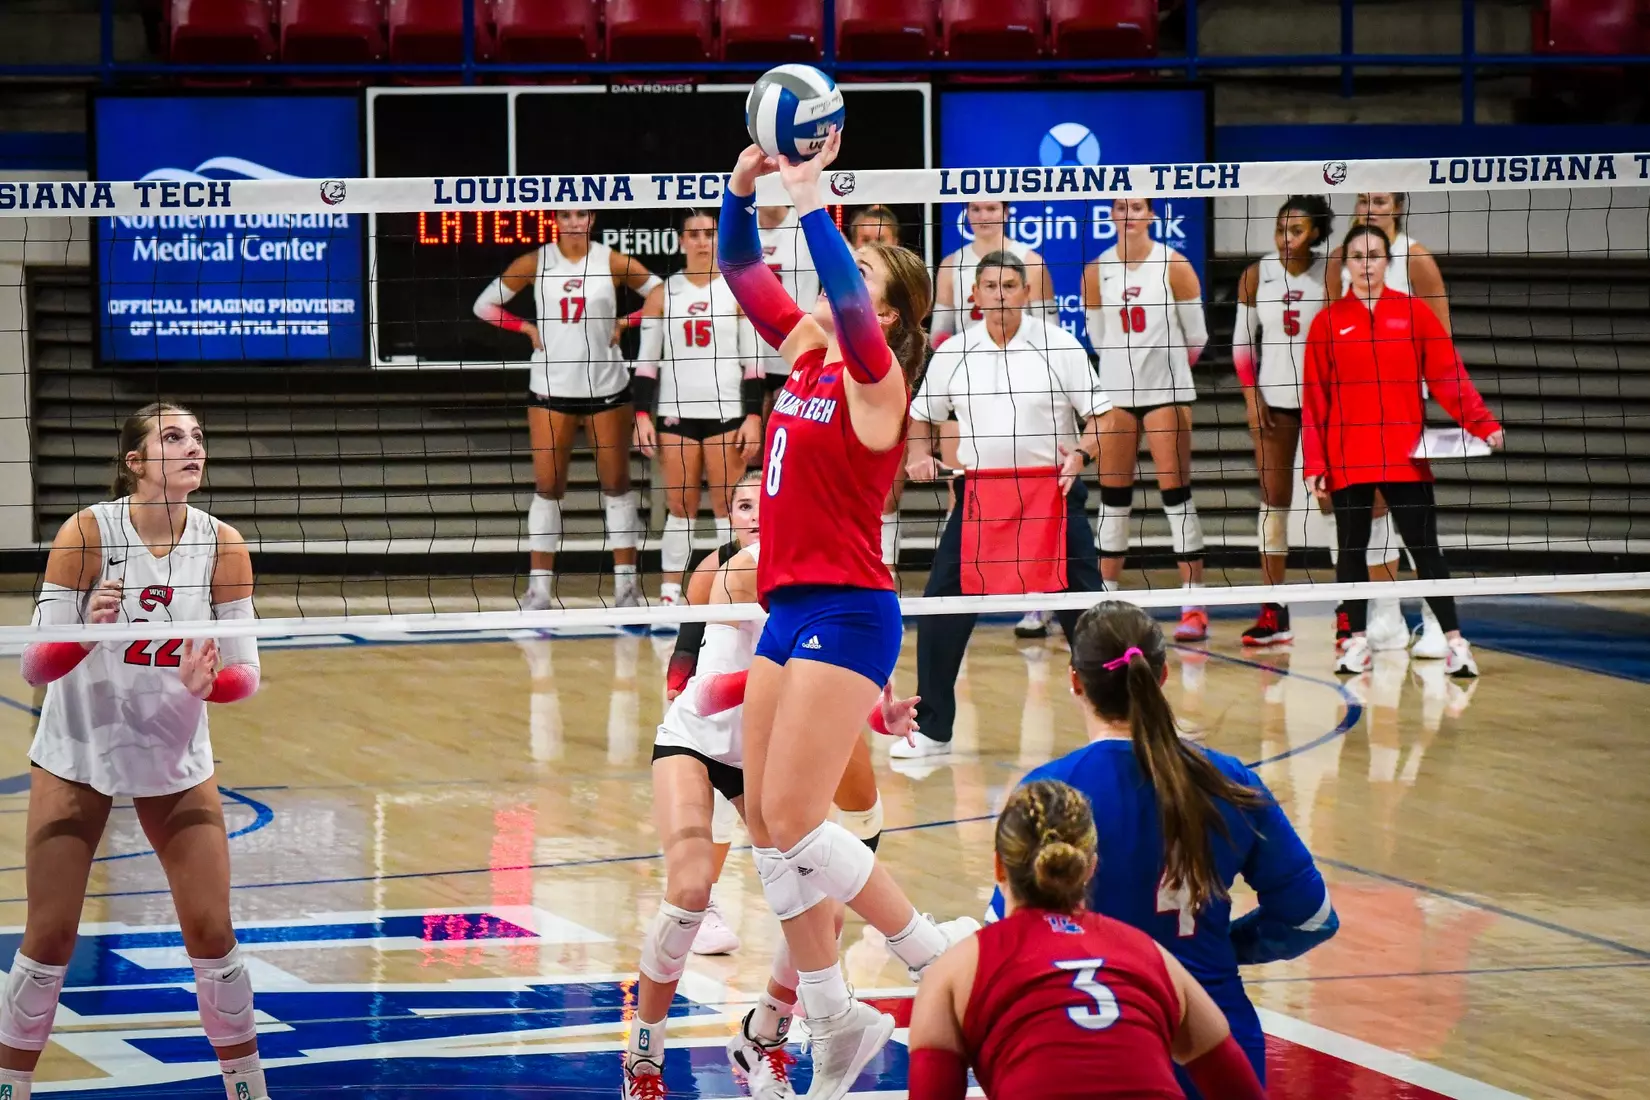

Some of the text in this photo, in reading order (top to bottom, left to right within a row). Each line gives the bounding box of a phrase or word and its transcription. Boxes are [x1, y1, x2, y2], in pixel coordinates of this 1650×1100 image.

[611, 84, 692, 93] DAKTRONICS
[939, 164, 1240, 195] LOUISIANA TECH
[1429, 155, 1616, 184] LOUISIANA
[134, 181, 231, 207] TECH
[434, 176, 633, 204] LOUISIANA
[957, 203, 1186, 249] Oigin Bnk
[132, 233, 327, 261] Medical Center
[602, 228, 685, 255] PERIO
[108, 298, 355, 314] OFFICIAL IMAGING PROVIDER
[560, 298, 586, 324] 17
[1120, 306, 1146, 333] 10
[129, 320, 330, 336] OF LATECH ATHLETICS
[684, 320, 712, 347] 15
[1283, 310, 1300, 336] 5
[766, 426, 787, 497] 8
[149, 588, 167, 598] WKU
[124, 618, 184, 667] 22
[1053, 958, 1121, 1031] 3
